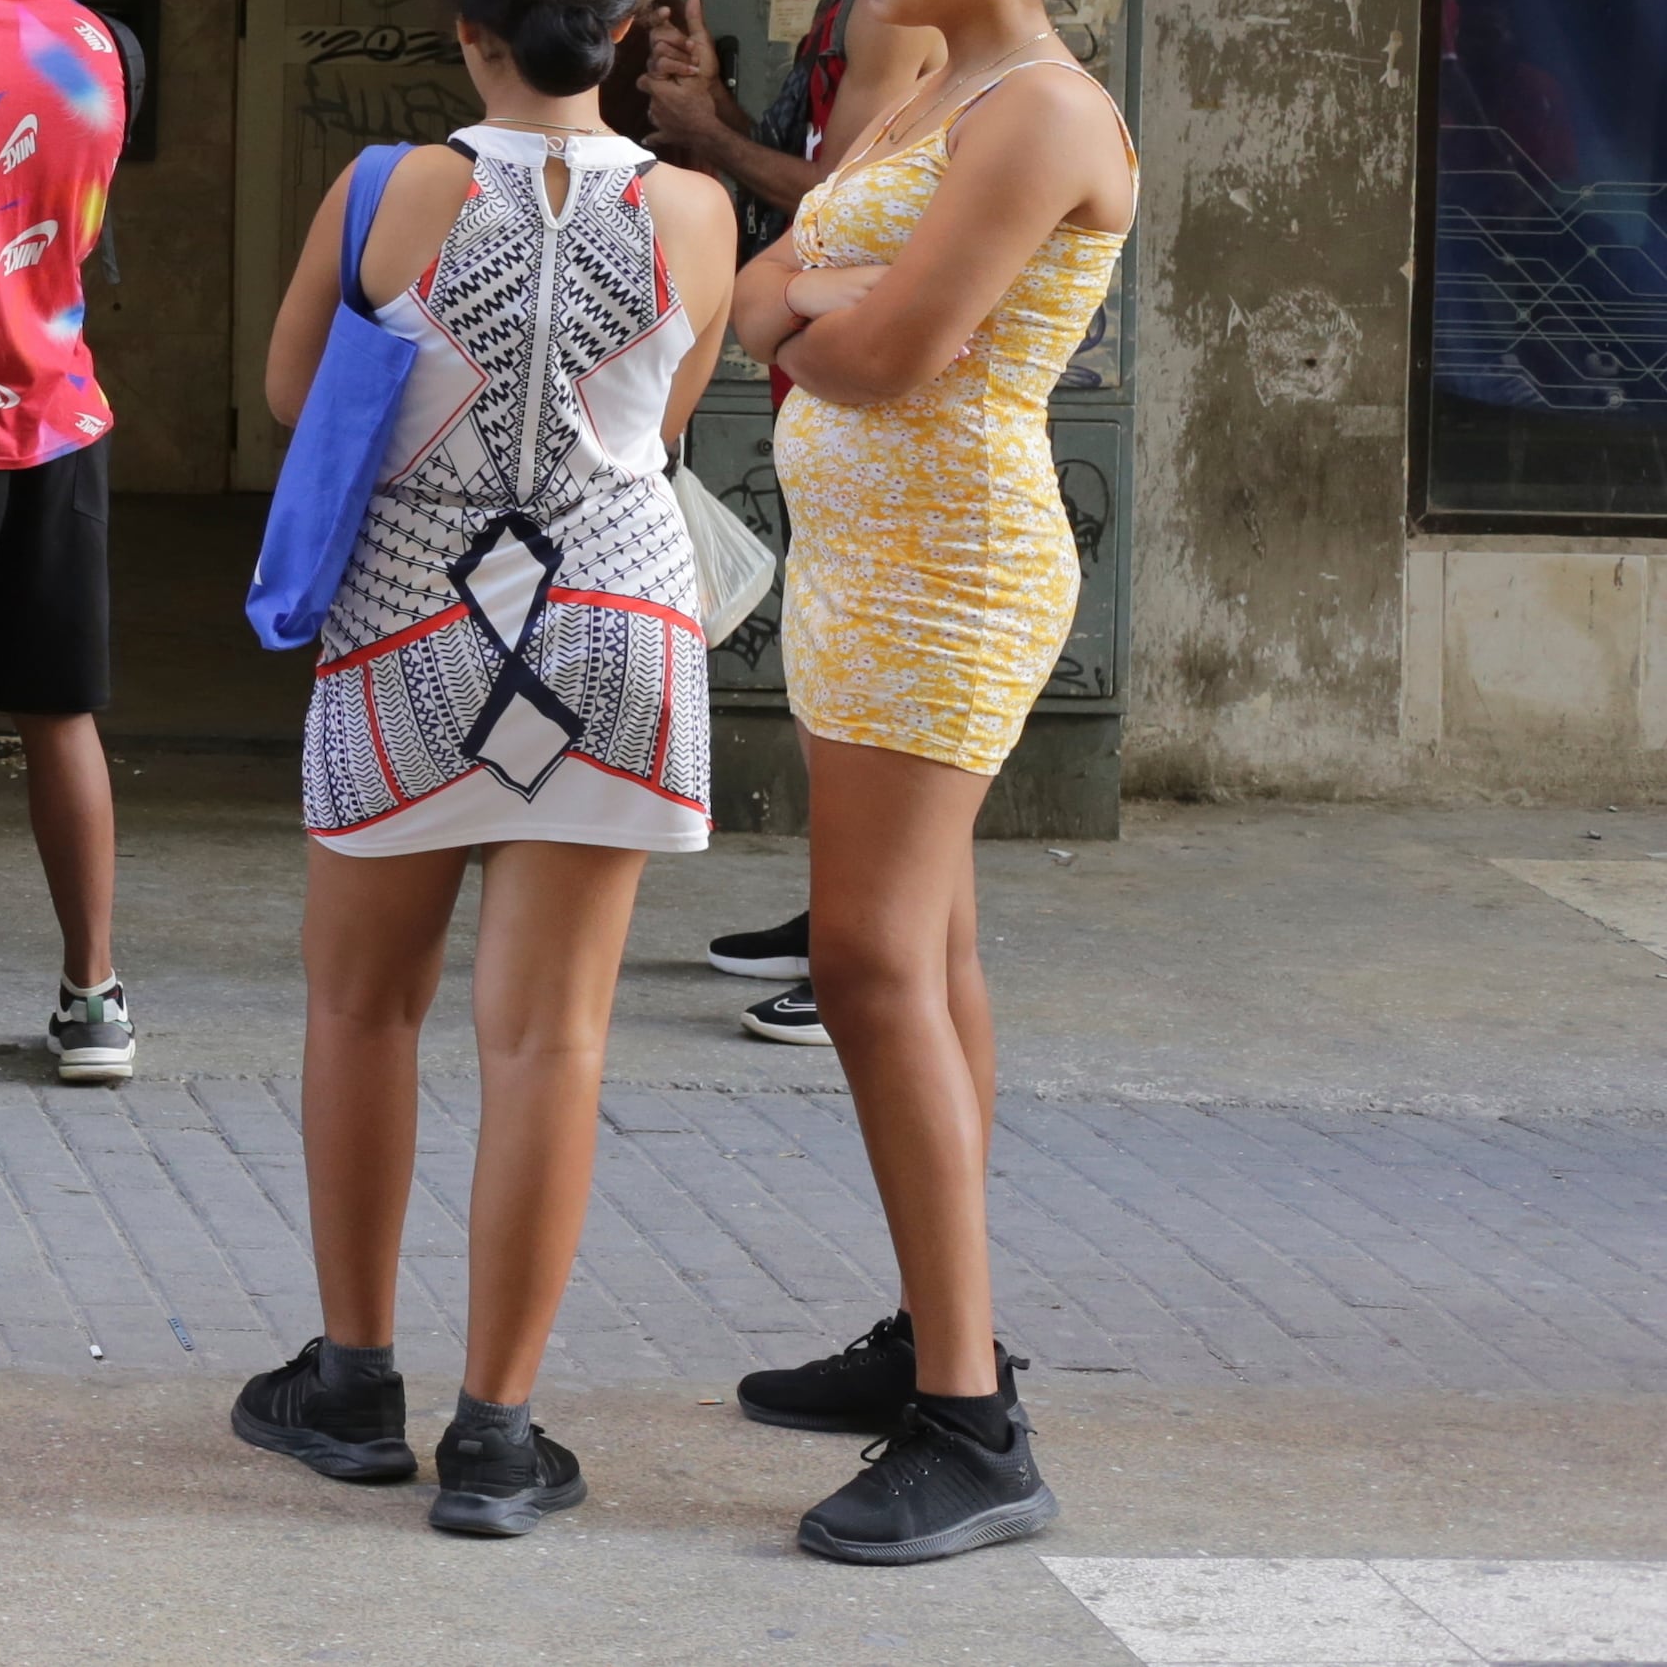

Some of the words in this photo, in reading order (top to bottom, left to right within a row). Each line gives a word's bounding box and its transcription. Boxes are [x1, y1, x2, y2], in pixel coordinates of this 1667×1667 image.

[73, 24, 104, 53] NIKE
[2, 131, 37, 175] NIKE
[3, 239, 47, 277] NIKE
